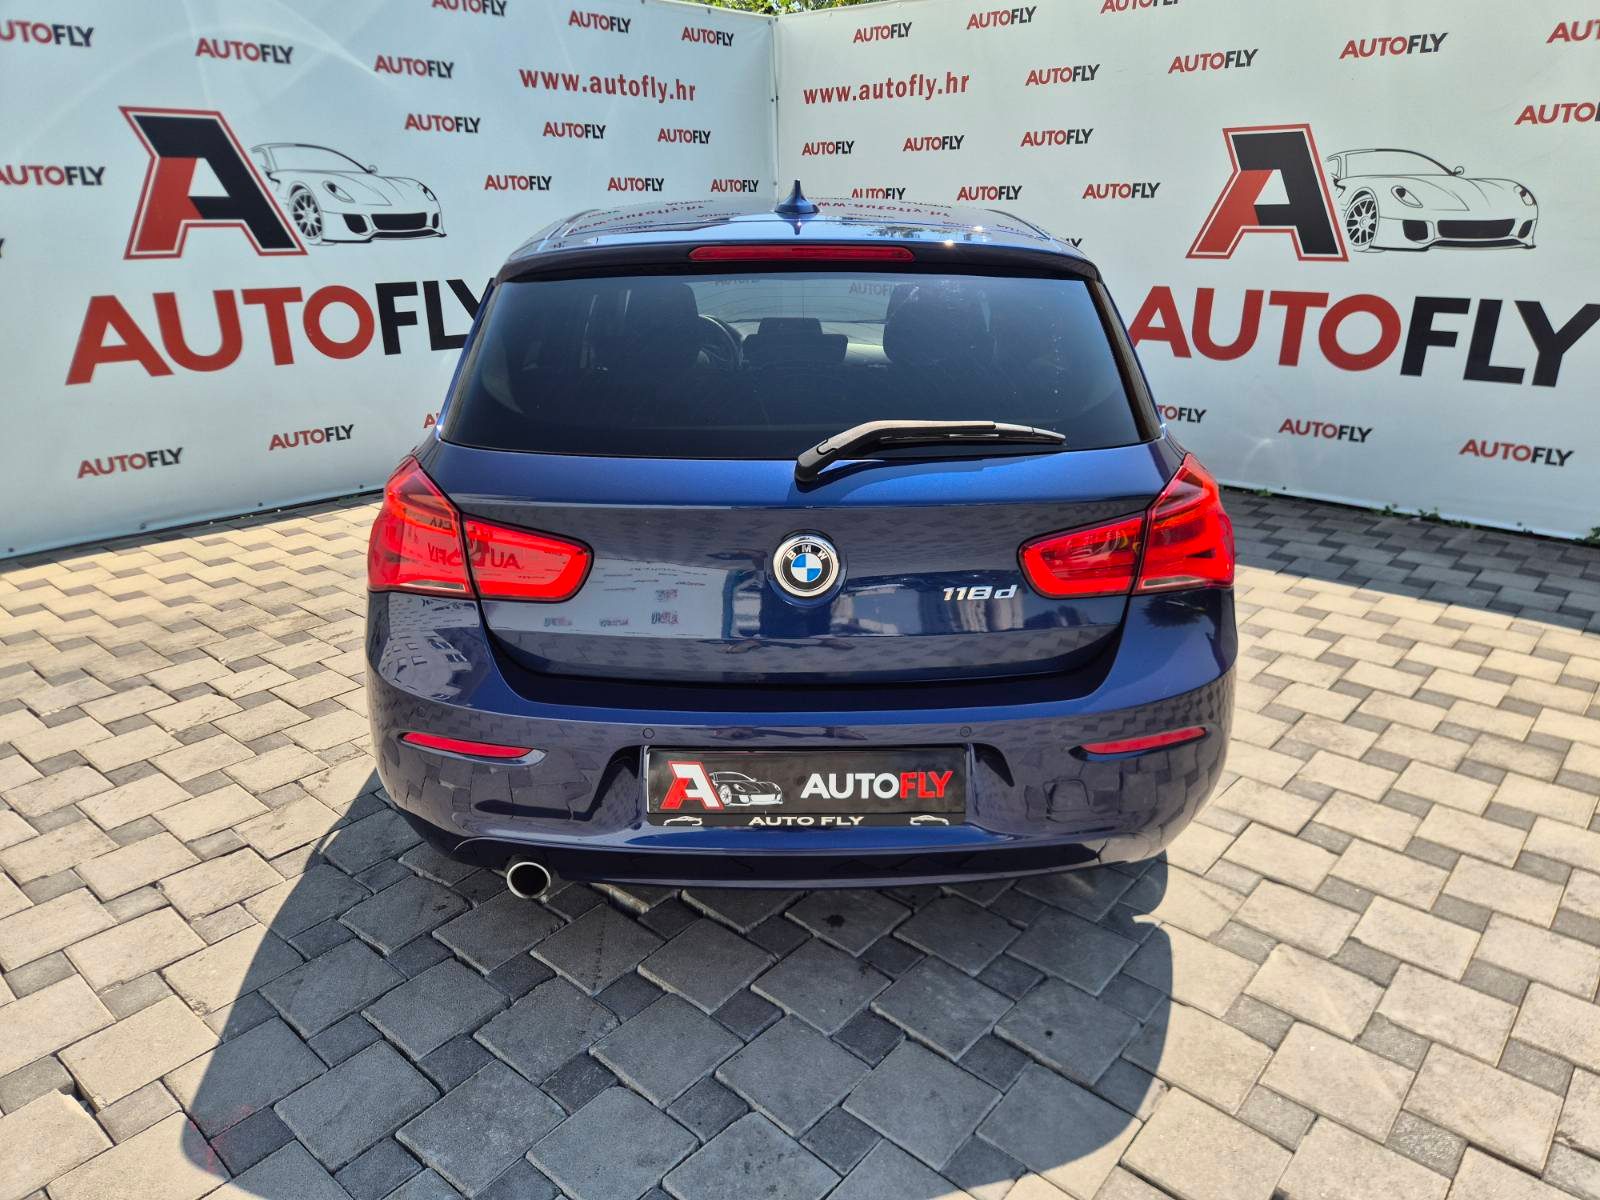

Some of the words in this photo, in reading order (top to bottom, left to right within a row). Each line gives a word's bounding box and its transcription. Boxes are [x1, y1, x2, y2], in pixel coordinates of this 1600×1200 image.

[569, 10, 631, 34] AUTOFLY
[967, 6, 1037, 30] AUTOFLY
[681, 27, 734, 47] AUTOFLY
[853, 22, 912, 43] AUTOFLY
[195, 38, 293, 64] AUTOFLY
[1339, 33, 1448, 59] AUTOFLY
[374, 55, 454, 79] AUTOFLY
[1168, 49, 1258, 74] AUTOFLY
[1025, 64, 1100, 86] AUTOFLY
[519, 69, 695, 103] www.autofly.hr
[803, 72, 969, 104] www.autofly.hr
[405, 113, 480, 133] AUTOFLY
[543, 122, 606, 139] AUTOFLY
[658, 128, 711, 145] AUTOFLY
[903, 135, 964, 152] AUTOFLY
[1020, 128, 1094, 147] AUTOFLY
[802, 141, 854, 156] AUTOFLY
[484, 175, 552, 191] AUTOFLY
[608, 177, 664, 192] AUTOFLY
[711, 179, 759, 193] AUTOFLY
[957, 185, 1022, 201] AUTOFLY
[1082, 182, 1160, 200] AUTOFLY
[1128, 286, 1600, 388] AUTOFLY
[269, 424, 354, 451] AUTOFLY
[1279, 419, 1372, 443] AUTOFLY
[78, 447, 183, 478] AUTOFLY
[1459, 439, 1574, 467] AUTOFLY
[786, 544, 828, 561] BMW
[943, 584, 1018, 601] 118d
[800, 770, 954, 799] AUTOFLY
[749, 816, 815, 826] AUTO
[820, 816, 865, 826] FLY
